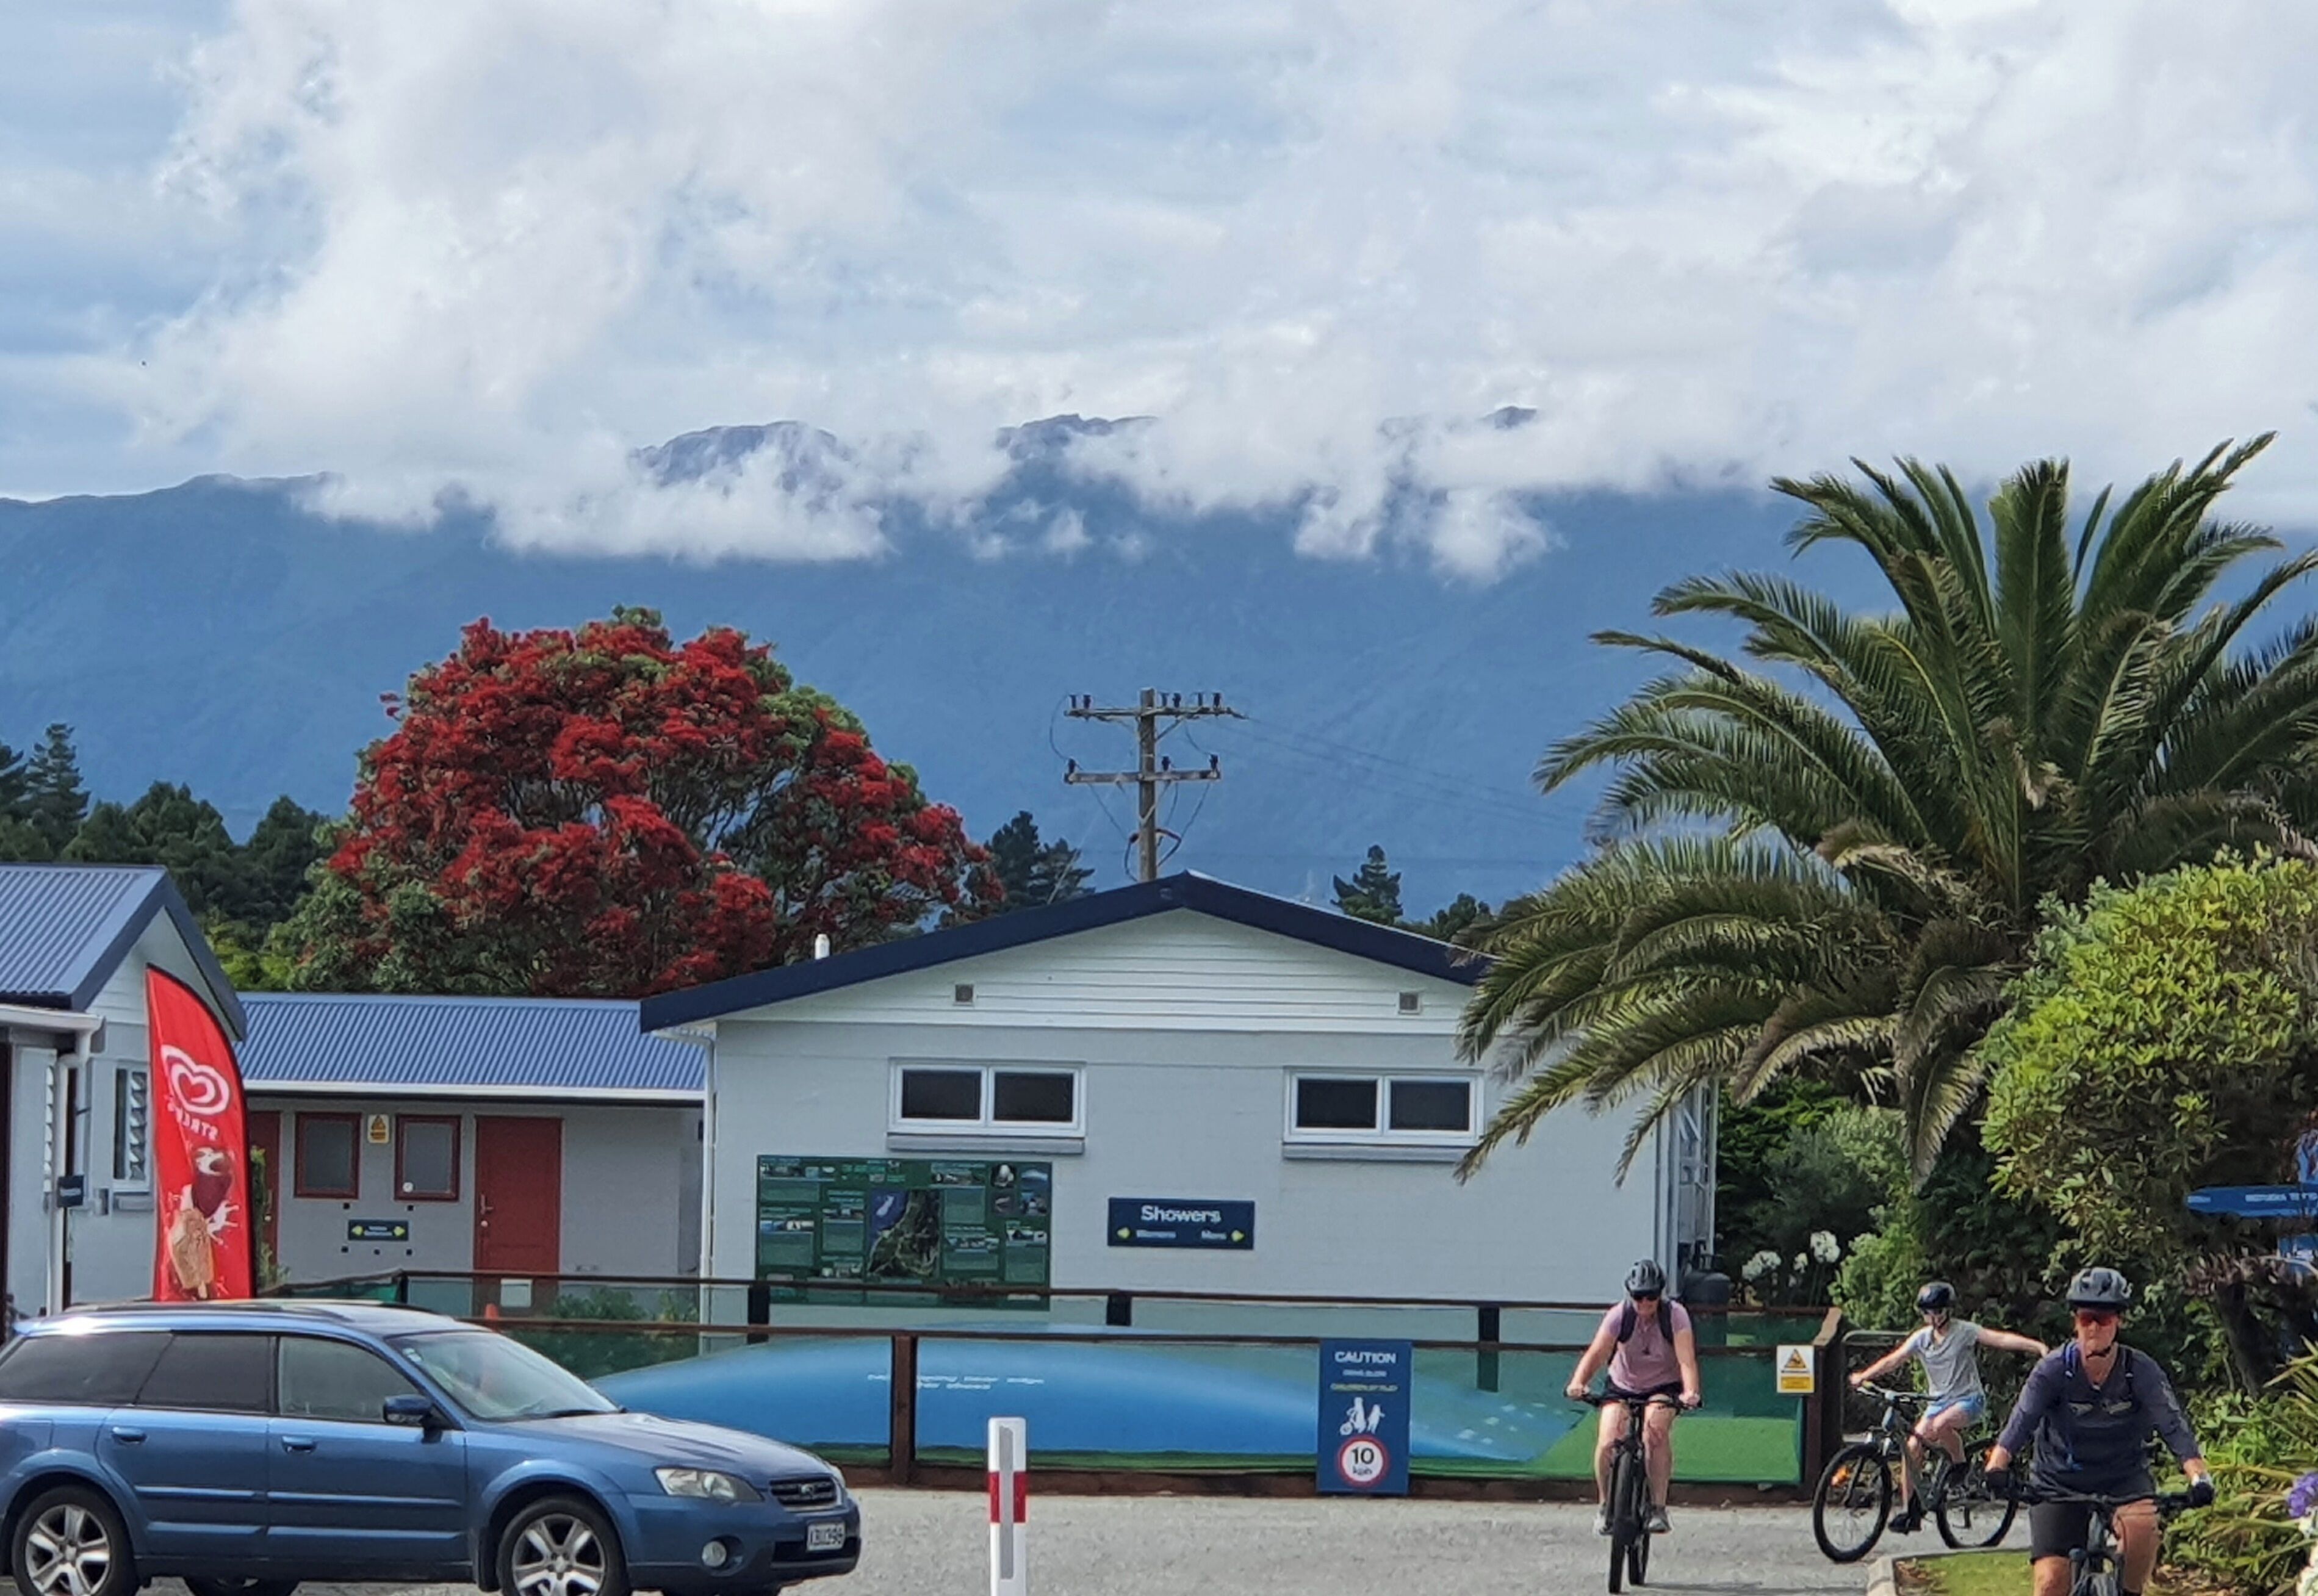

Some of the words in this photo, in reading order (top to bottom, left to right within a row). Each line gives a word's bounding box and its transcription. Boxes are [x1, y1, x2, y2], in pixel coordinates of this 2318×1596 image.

[1141, 1204, 1221, 1223] Showers
[1334, 1351, 1396, 1364] CAUTION
[1352, 1447, 1374, 1465] 10
